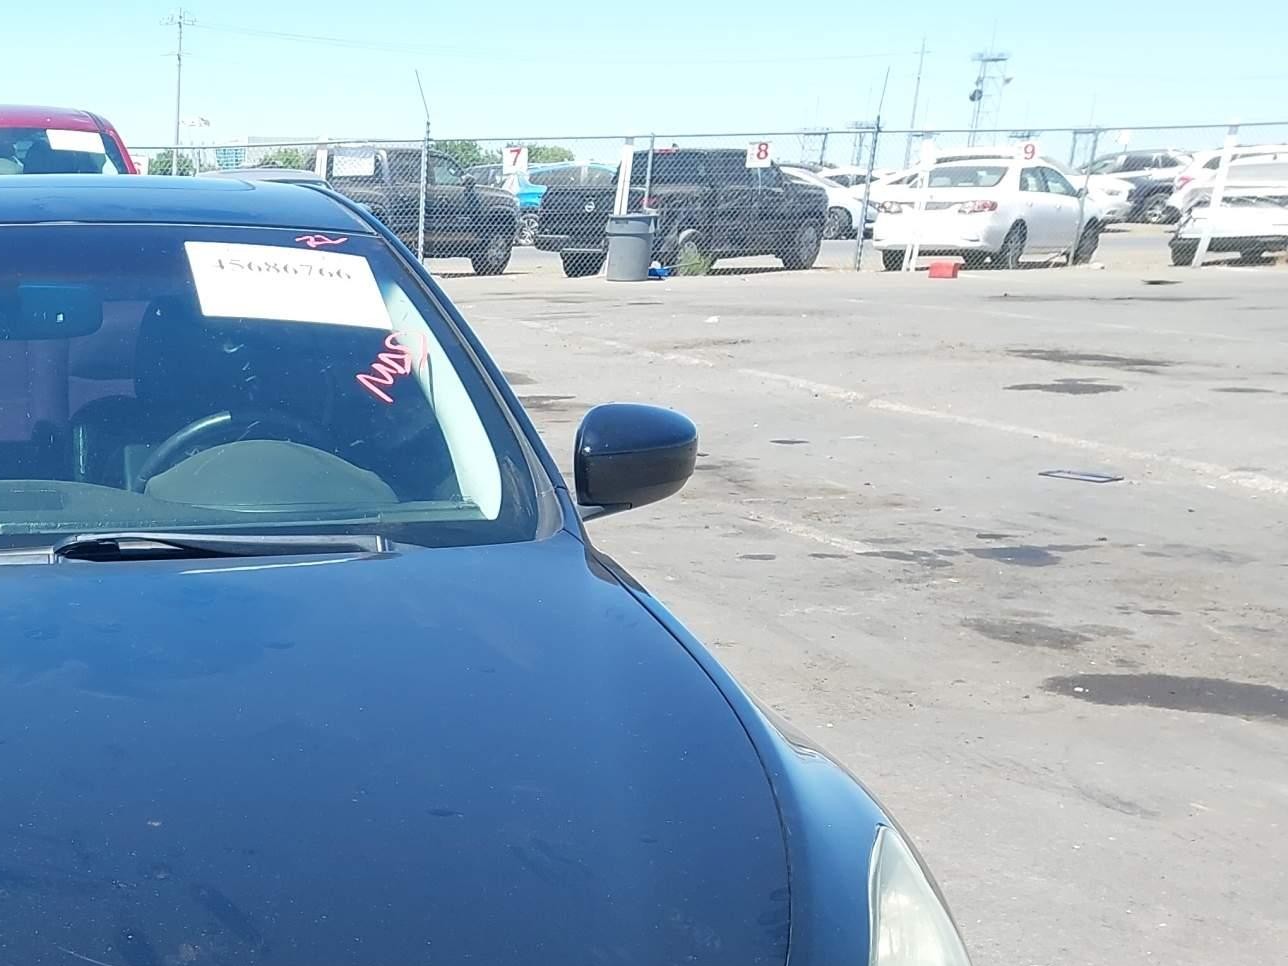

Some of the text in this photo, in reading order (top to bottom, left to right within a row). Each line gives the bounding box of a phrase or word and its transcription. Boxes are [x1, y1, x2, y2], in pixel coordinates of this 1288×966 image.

[510, 148, 522, 167] 7
[756, 142, 769, 160] 8
[1023, 143, 1036, 160] 9
